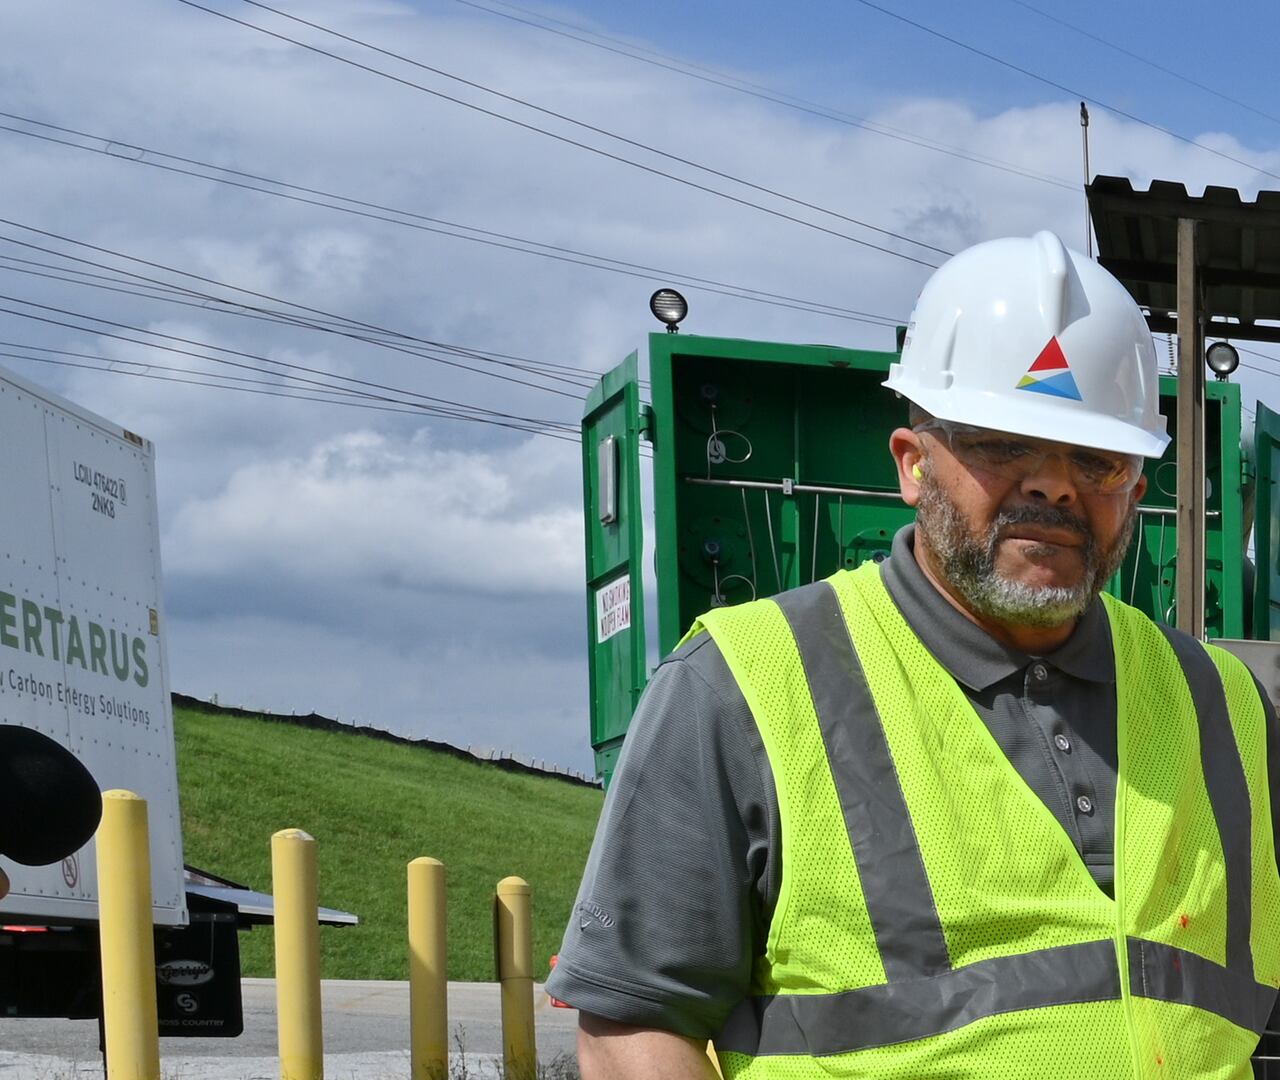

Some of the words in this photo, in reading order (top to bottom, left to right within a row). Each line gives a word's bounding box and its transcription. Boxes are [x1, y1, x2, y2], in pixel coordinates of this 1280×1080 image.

[0, 591, 148, 688] ERTARUS
[9, 669, 52, 699] Carbon
[58, 683, 95, 716] Energy
[100, 695, 150, 725] Solutions
